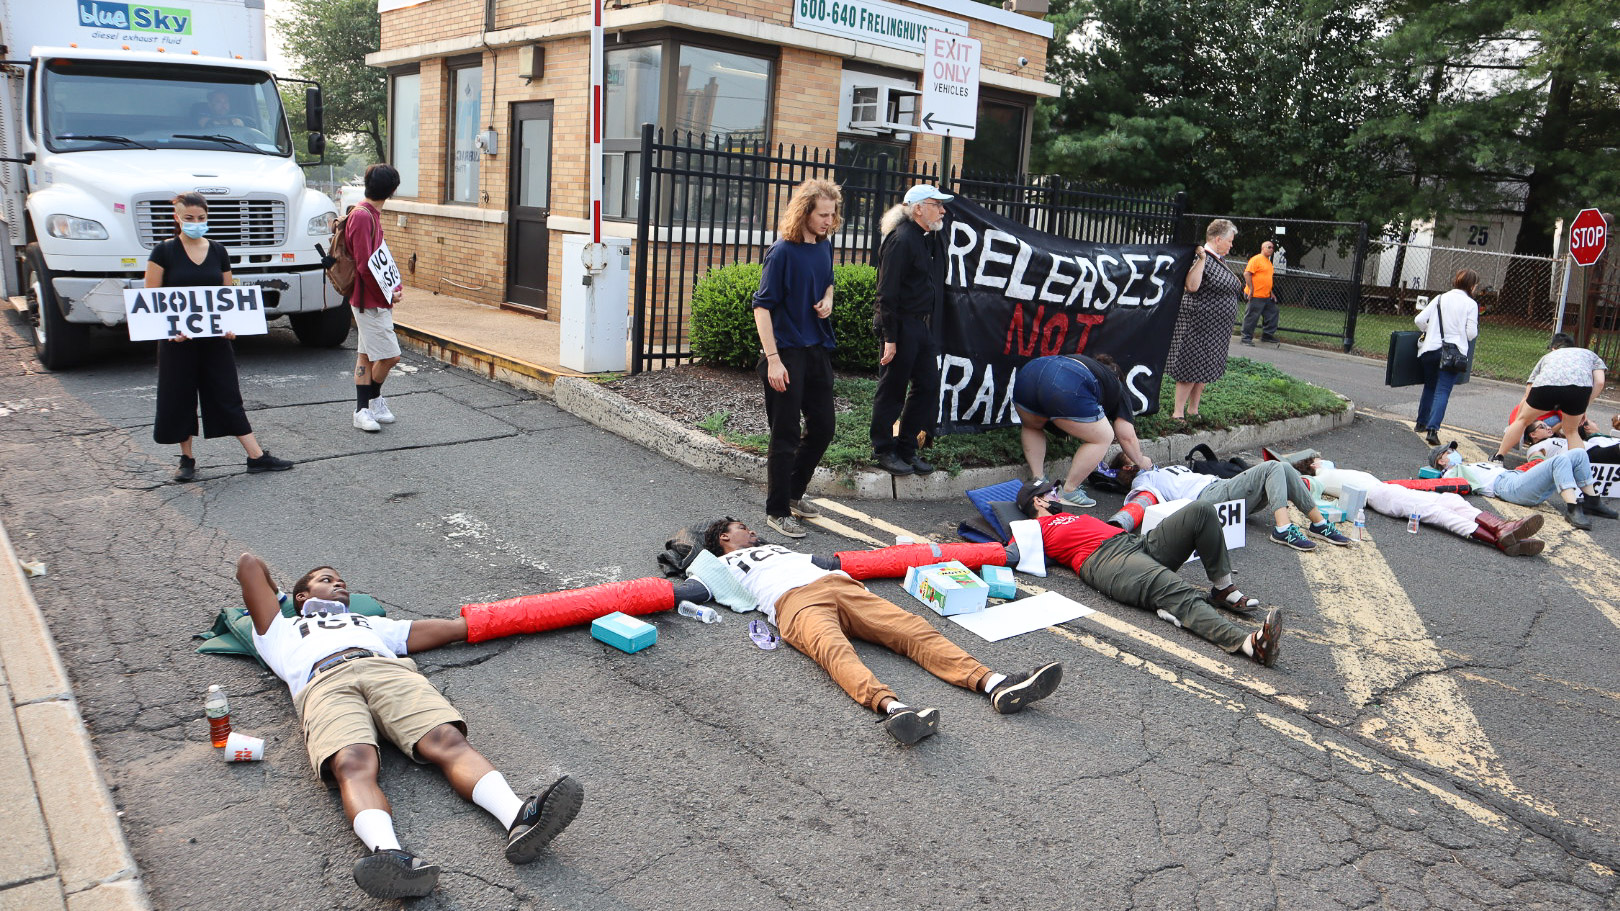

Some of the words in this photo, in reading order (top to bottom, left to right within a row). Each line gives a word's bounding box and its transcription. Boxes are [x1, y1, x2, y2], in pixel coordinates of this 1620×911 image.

[80, 3, 128, 28] blue
[134, 8, 188, 32] Sky
[801, 0, 857, 28] 600-640
[859, 8, 939, 43] FRELINGHUYS
[92, 31, 118, 40] diesel
[122, 35, 158, 43] exhaust
[162, 36, 182, 45] fluid
[934, 39, 972, 62] EXIT
[933, 61, 971, 83] ONLY
[934, 82, 969, 97] VEHICLES
[1467, 225, 1488, 246] 25
[1572, 226, 1604, 249] STOP
[945, 221, 1175, 311] RELEASES
[131, 288, 258, 314] ABOLISH
[167, 313, 223, 336] ICE
[1003, 303, 1105, 357] NOT
[1591, 465, 1620, 482] OLIS
